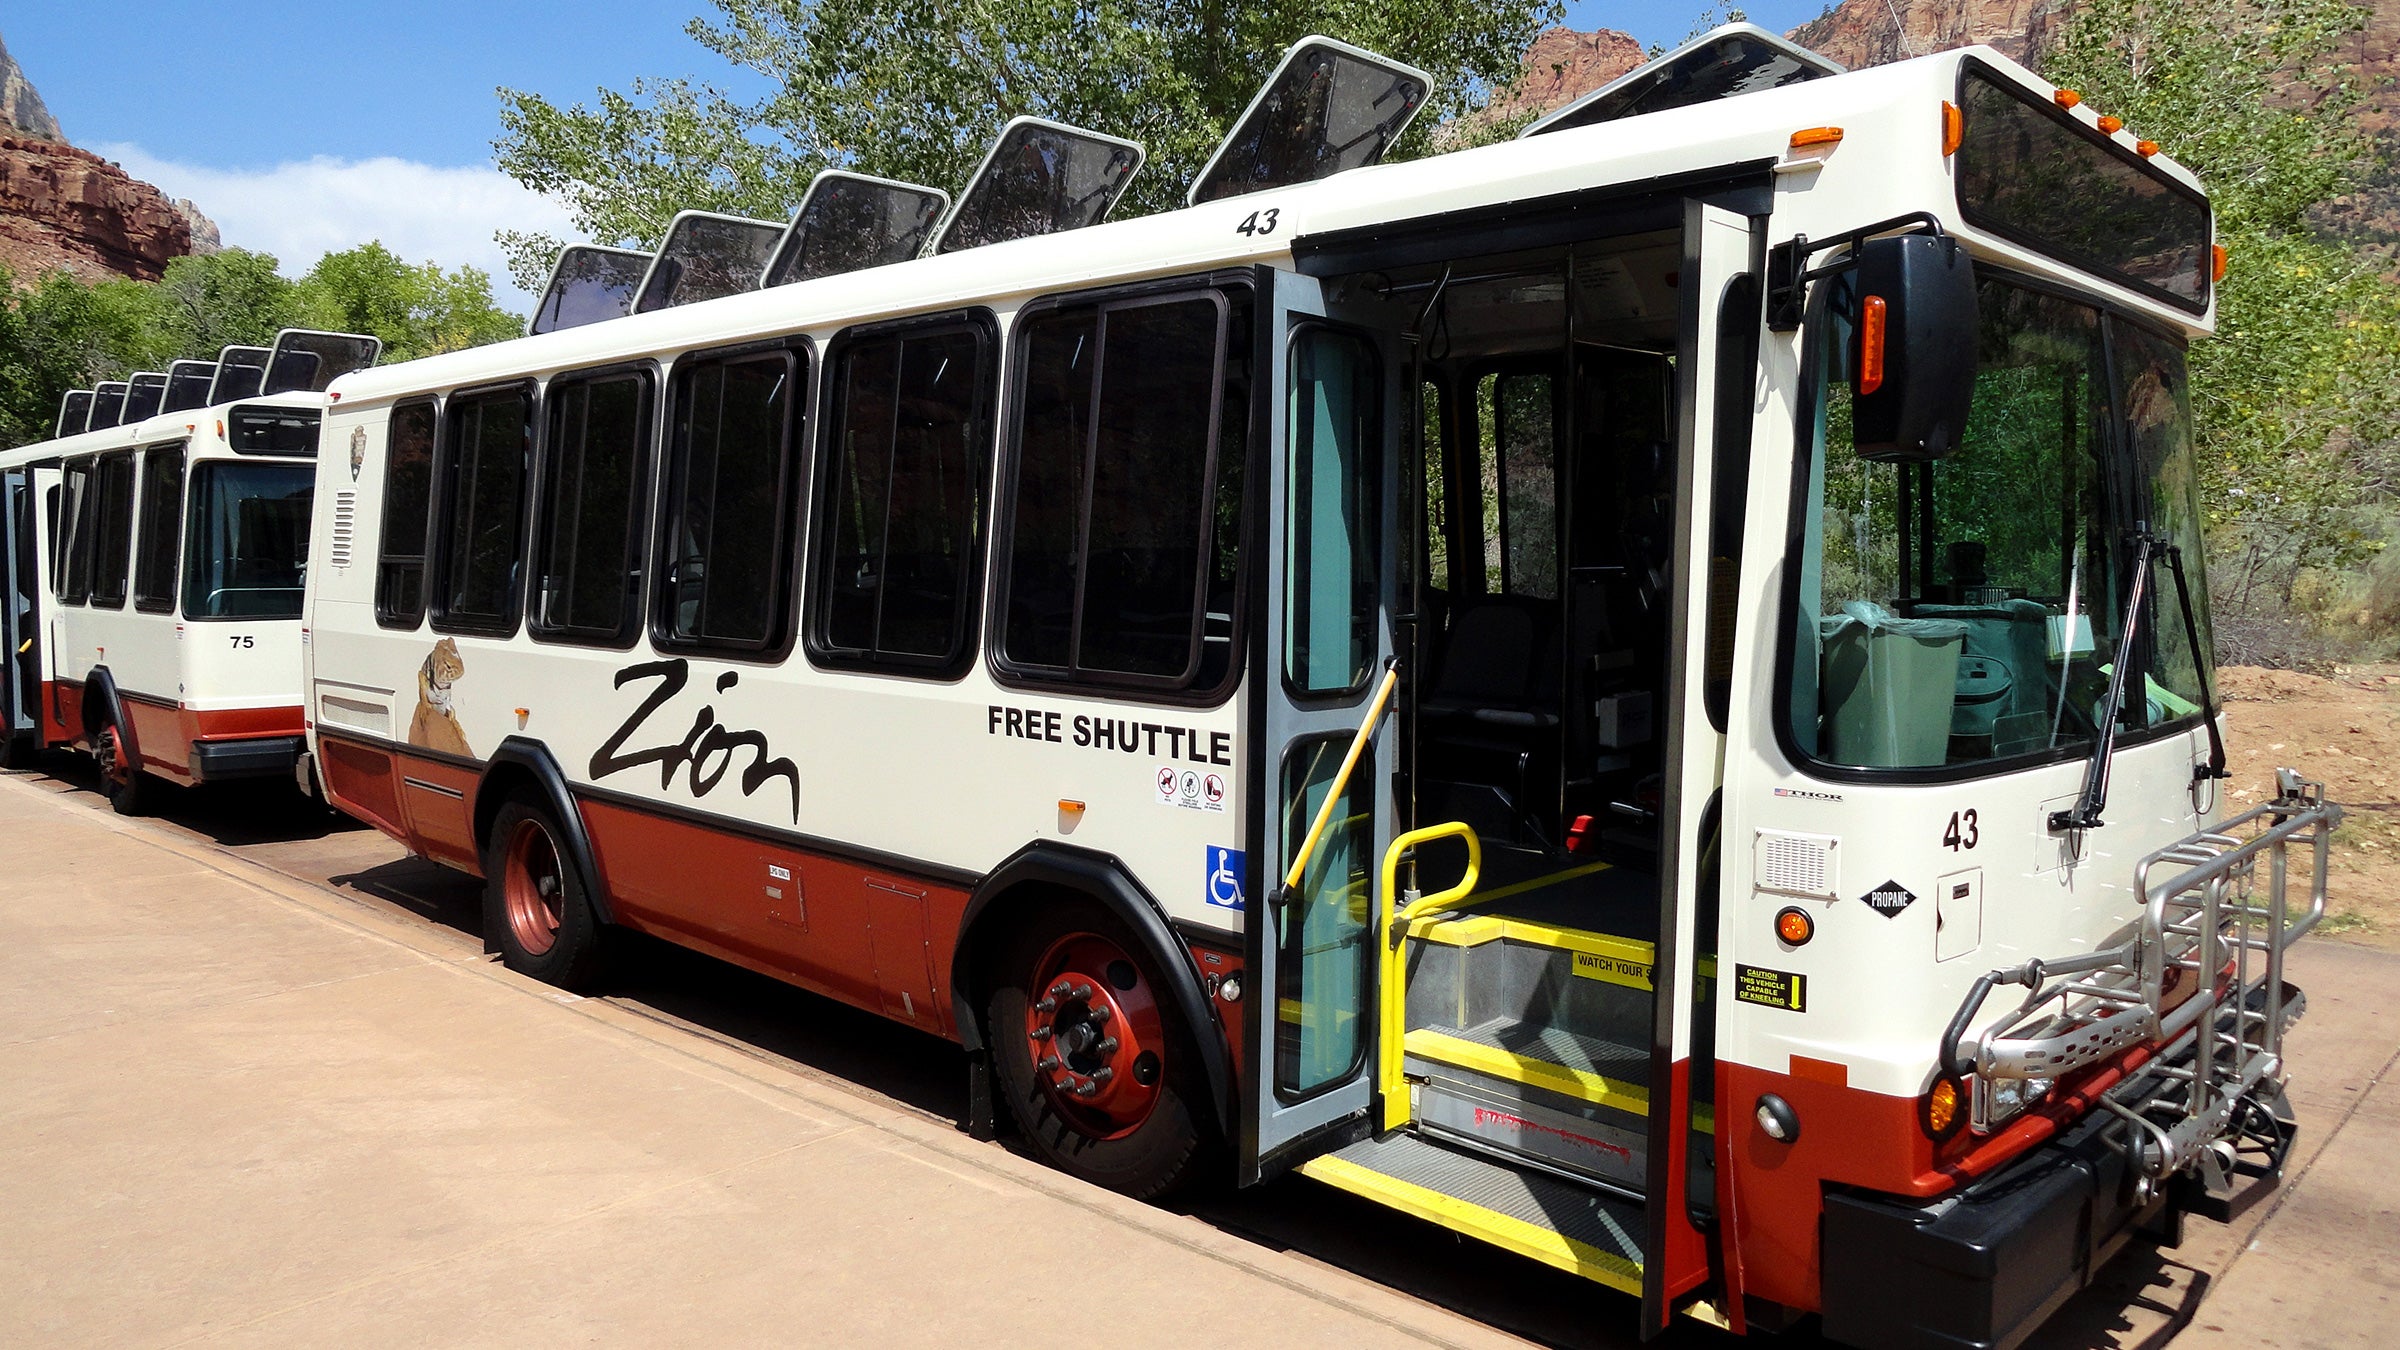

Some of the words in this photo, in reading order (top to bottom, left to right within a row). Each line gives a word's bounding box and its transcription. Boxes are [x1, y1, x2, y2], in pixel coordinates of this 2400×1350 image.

[1236, 208, 1280, 237] 43
[230, 636, 254, 649] 75
[589, 658, 800, 825] Zion
[988, 705, 1062, 743] FREE
[1072, 715, 1231, 766] SHUTTLE
[1788, 790, 1843, 800] THOR
[1943, 808, 1979, 852] 43
[1871, 891, 1908, 908] PROPANE
[1578, 954, 1612, 971] WATCH
[1616, 962, 1643, 977] YOUR
[1746, 969, 1778, 980] CAUTION
[1740, 976, 1755, 985] THIS
[1755, 979, 1785, 990] VEHICLE
[1746, 985, 1778, 996] CAPABLE
[1750, 993, 1785, 1005] KNEELING
